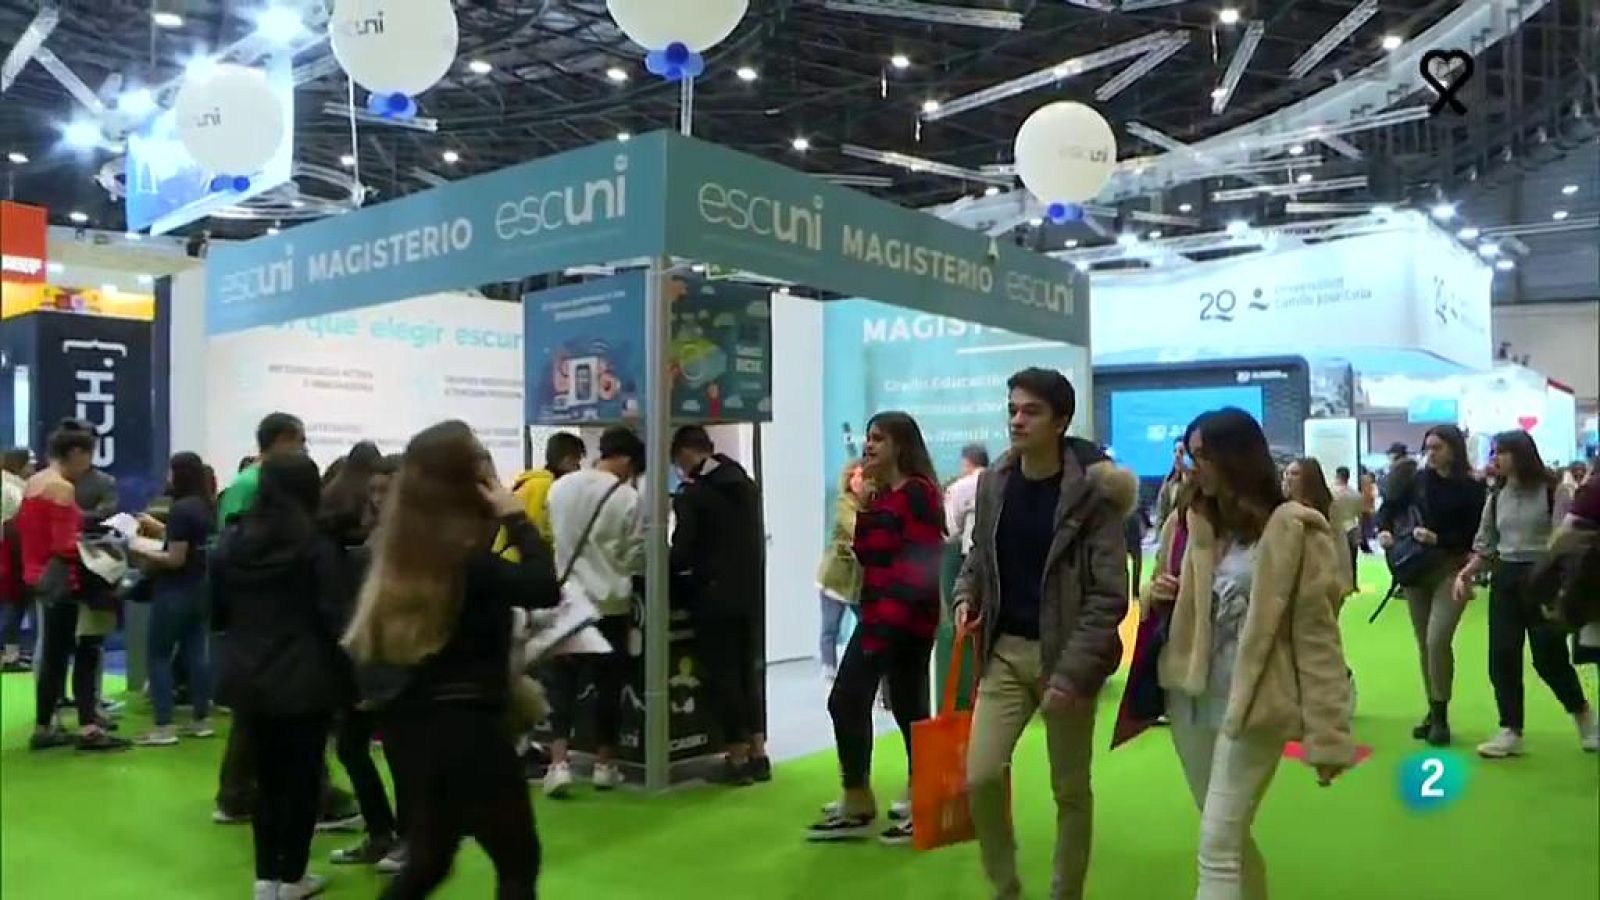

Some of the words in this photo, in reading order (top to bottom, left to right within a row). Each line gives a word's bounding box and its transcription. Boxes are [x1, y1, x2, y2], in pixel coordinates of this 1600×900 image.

[221, 243, 293, 304] escuni
[308, 218, 473, 283] MAGISTERIO
[494, 155, 628, 240] escuni
[698, 182, 824, 251] escuni
[842, 224, 995, 294] MAGISTERIO
[1006, 270, 1074, 316] escuni
[1200, 289, 1236, 320] 20
